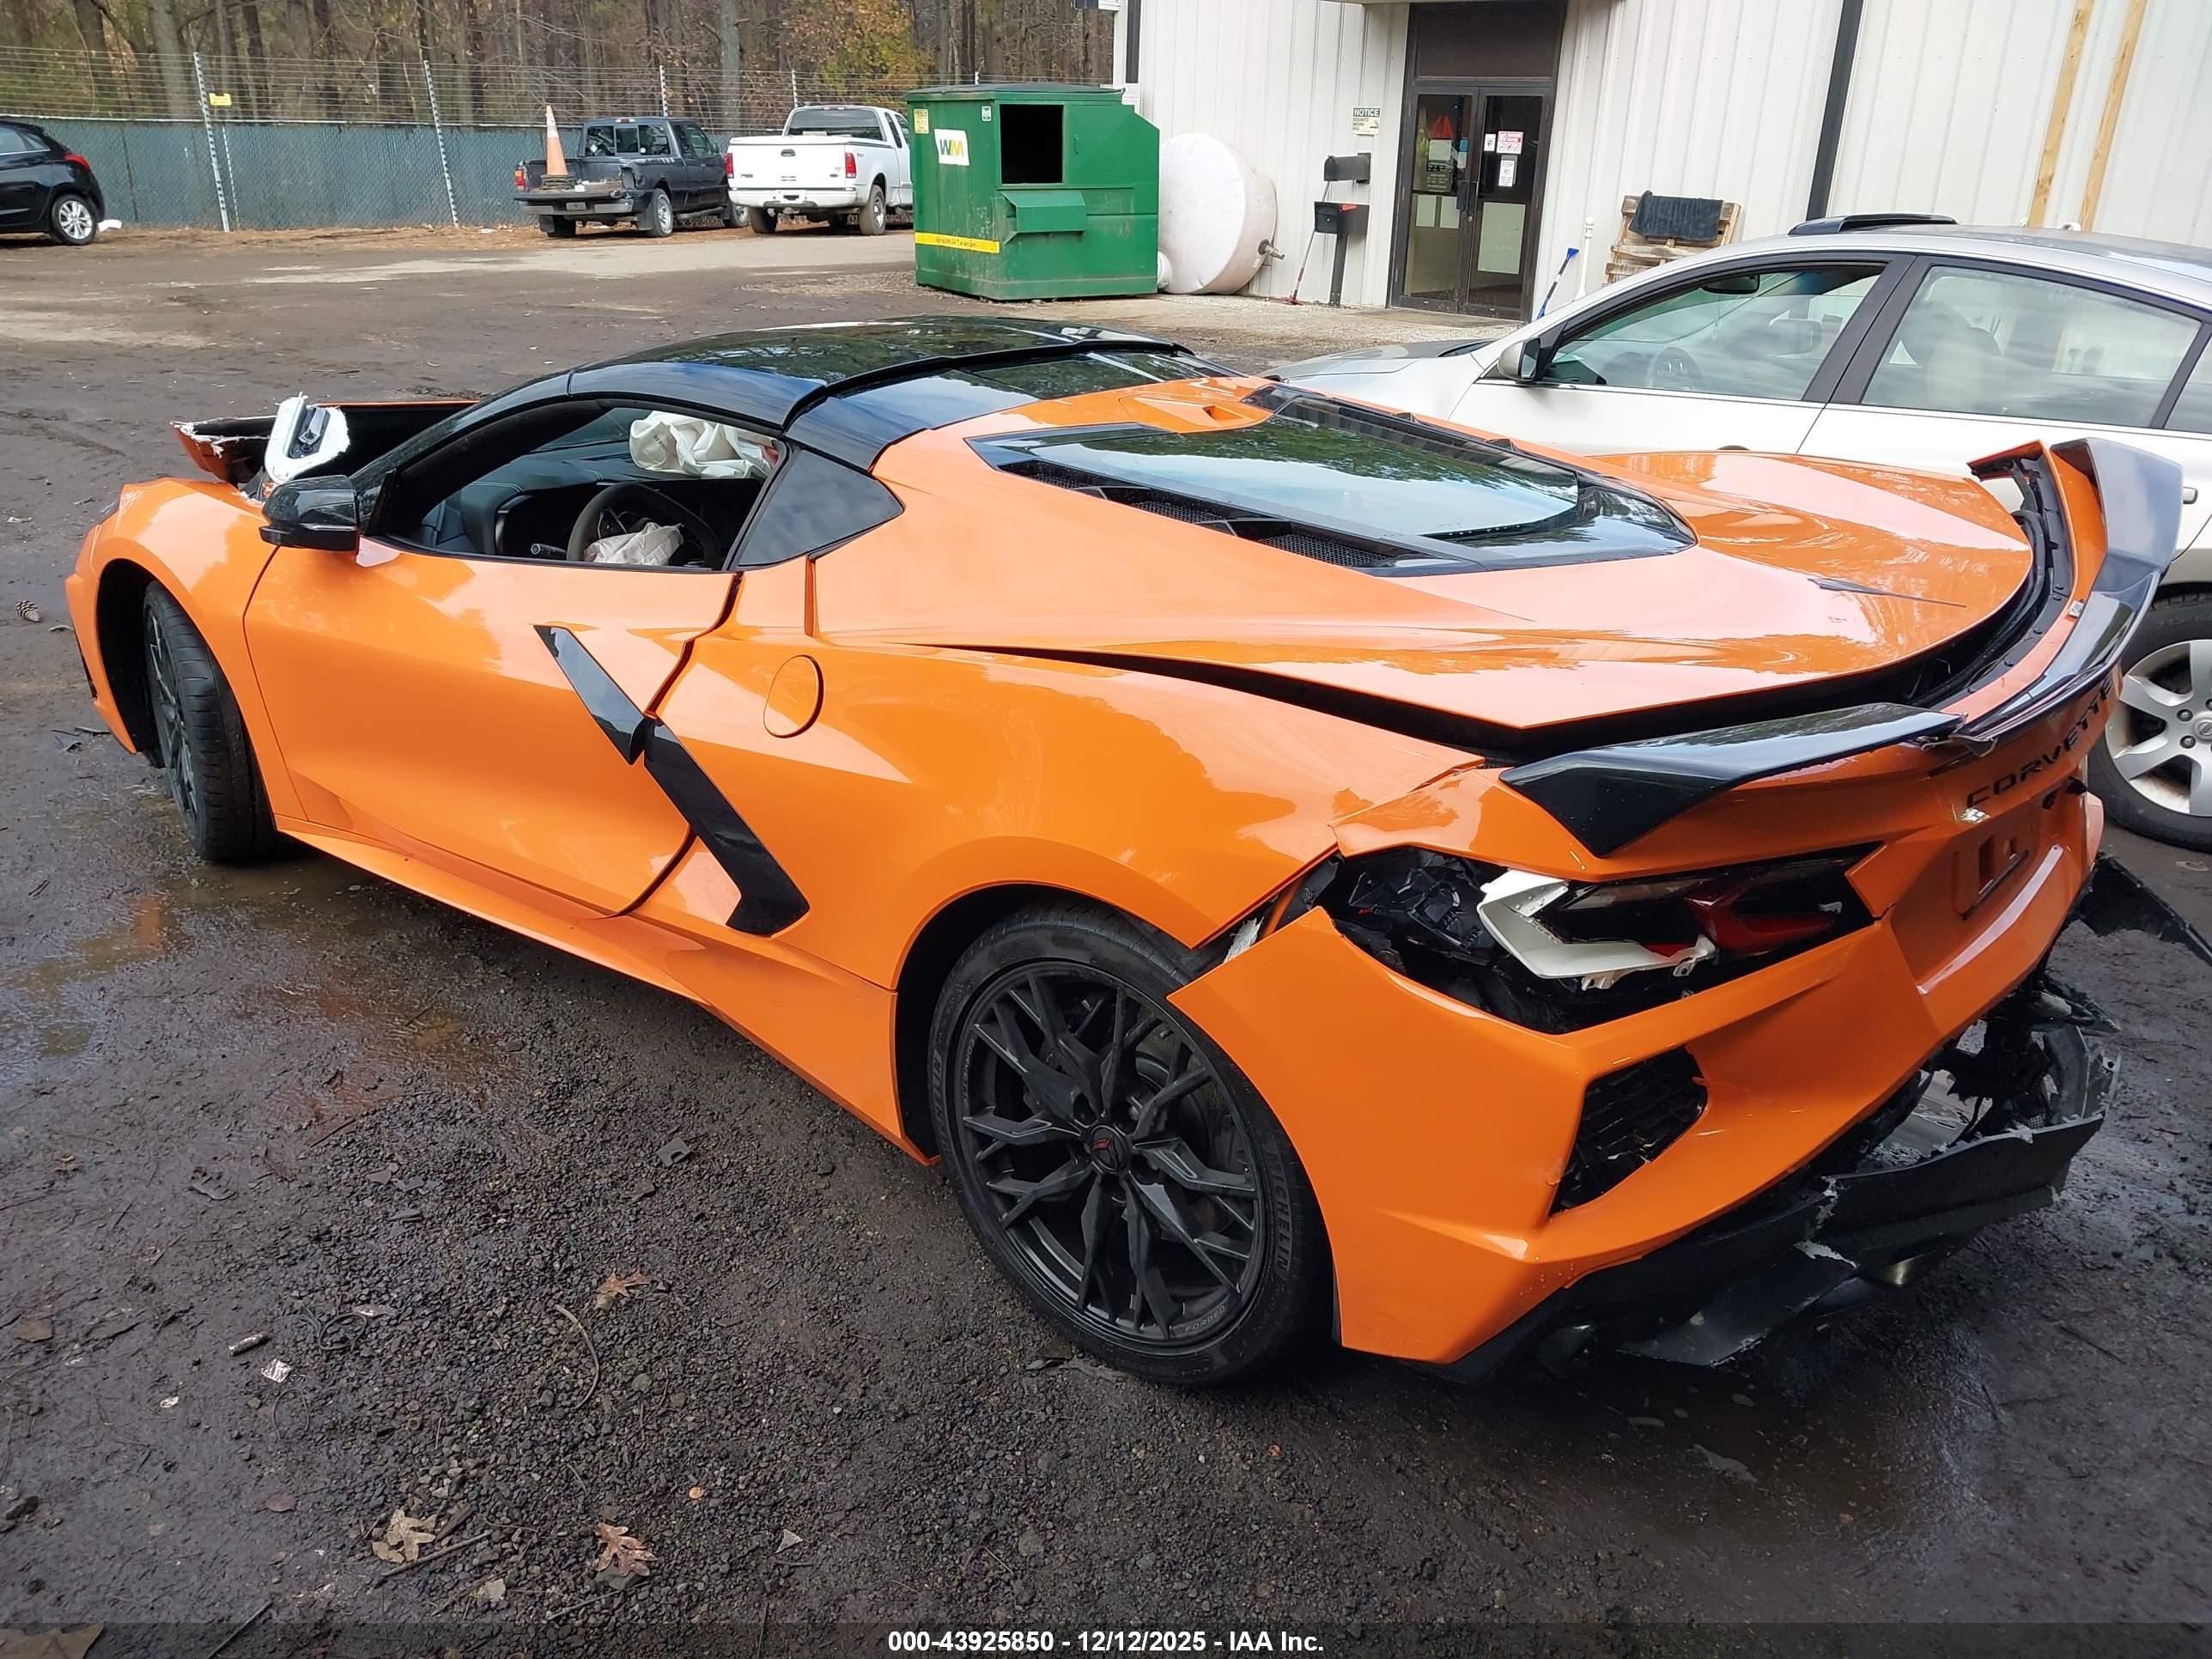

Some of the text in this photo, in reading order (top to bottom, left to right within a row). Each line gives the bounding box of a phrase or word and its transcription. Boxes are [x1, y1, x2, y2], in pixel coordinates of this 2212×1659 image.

[1354, 108, 1379, 117] NOTICE
[939, 138, 964, 157] WM
[1966, 678, 2113, 808] CORVETTE
[1267, 1152, 1291, 1272] MICHELIN
